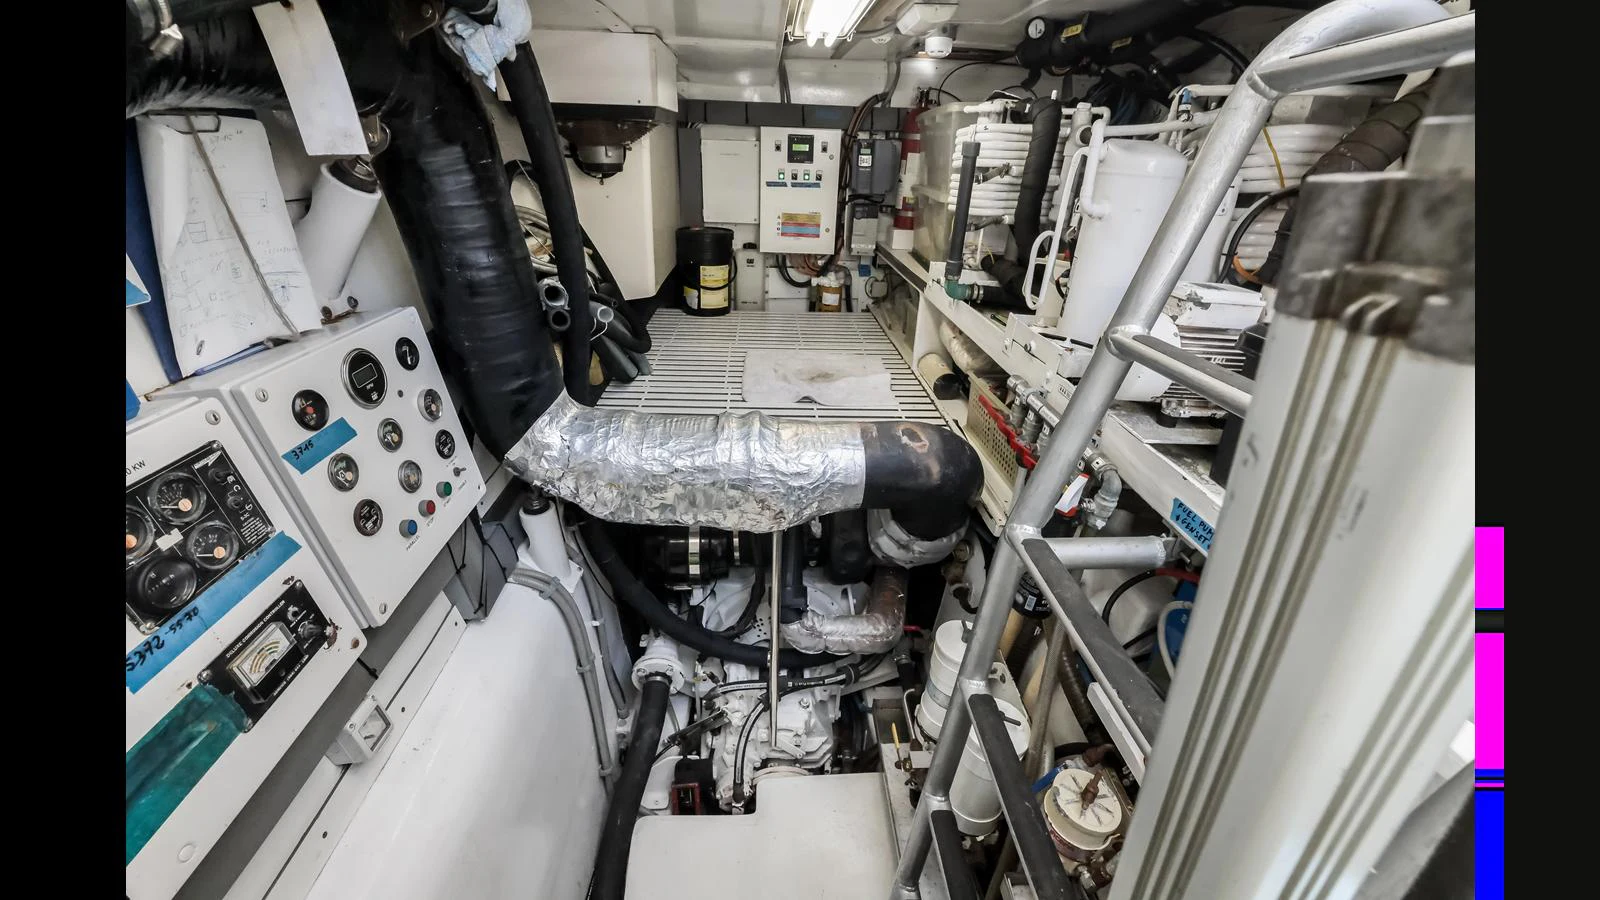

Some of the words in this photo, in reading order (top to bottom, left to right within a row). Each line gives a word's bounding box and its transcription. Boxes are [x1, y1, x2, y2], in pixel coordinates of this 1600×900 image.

[1177, 502, 1197, 522] FUEL
[1199, 521, 1214, 540] PUM
[1181, 517, 1209, 544] GENSET
[226, 641, 243, 658] DELUXE
[263, 600, 285, 622] CONTROLLER
